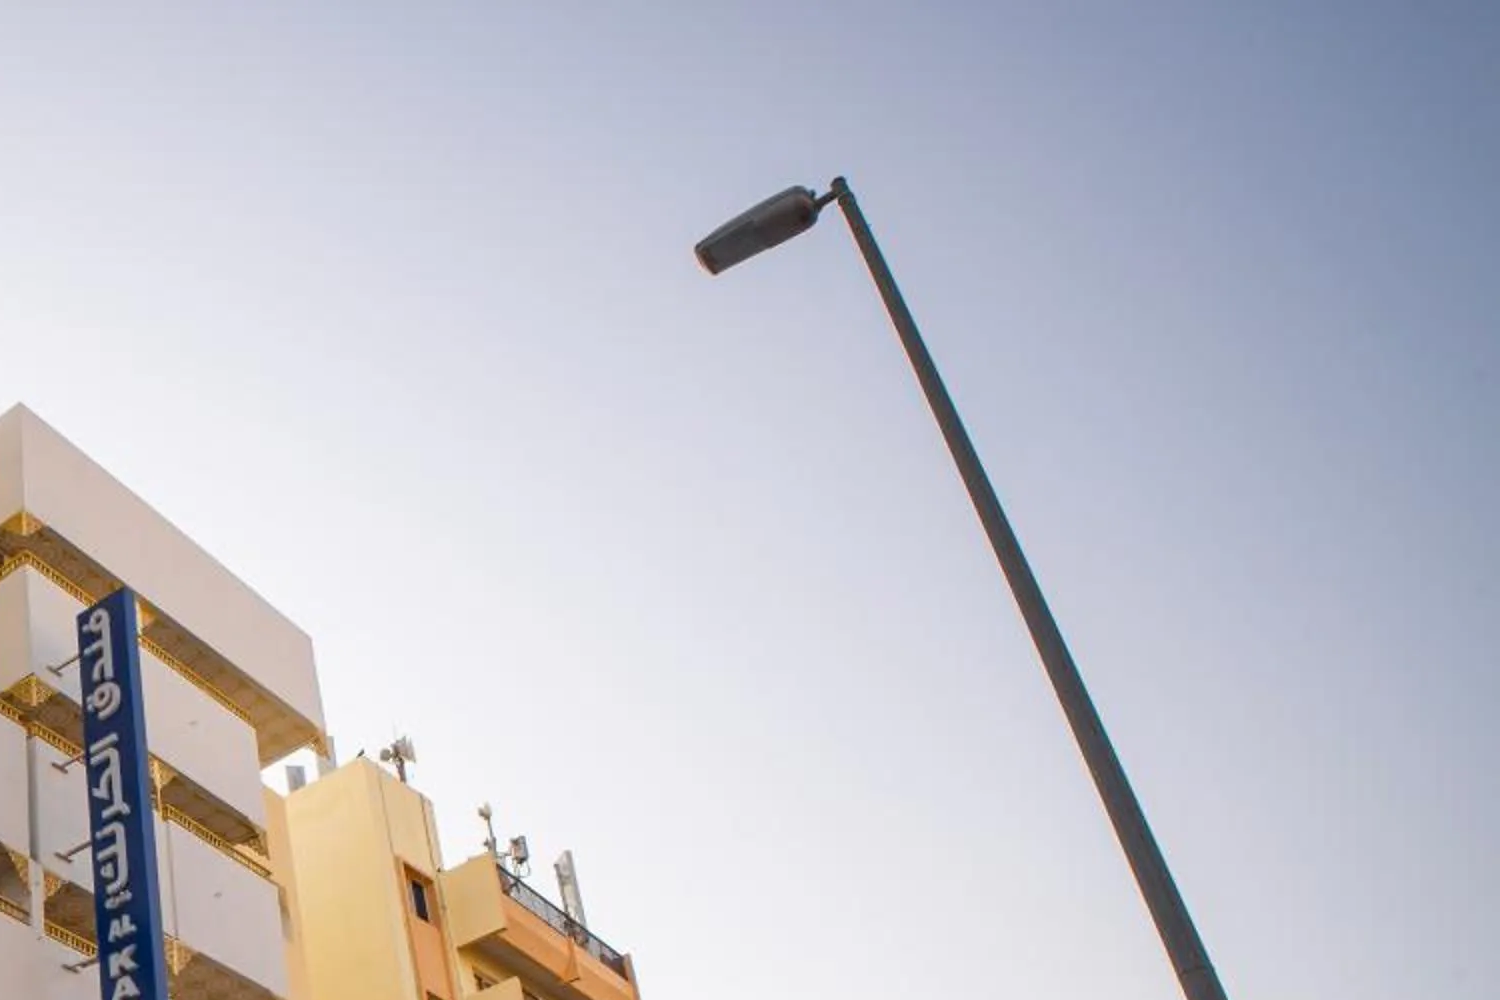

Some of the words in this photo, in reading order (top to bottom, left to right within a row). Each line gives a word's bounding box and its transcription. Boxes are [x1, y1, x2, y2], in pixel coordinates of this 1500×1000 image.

[83, 607, 121, 719] فندق
[89, 732, 133, 909] الكرنك
[108, 913, 137, 942] AL
